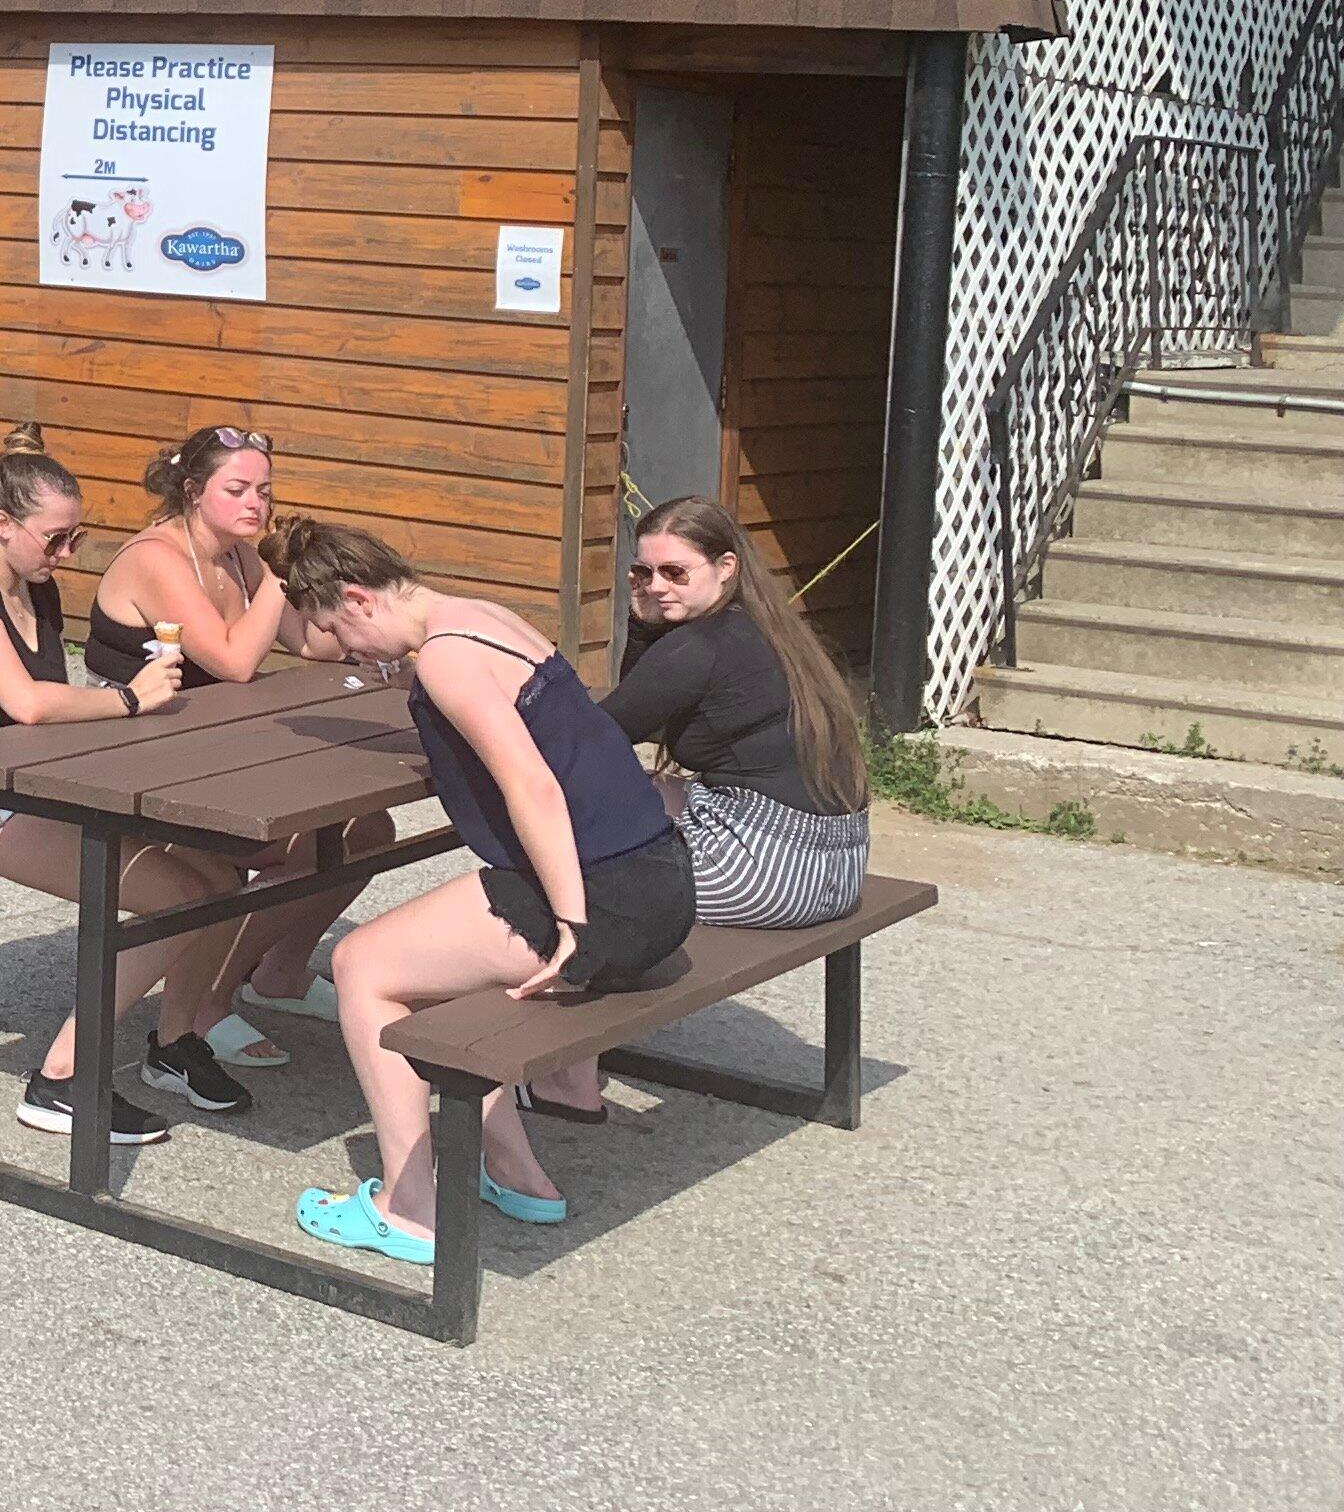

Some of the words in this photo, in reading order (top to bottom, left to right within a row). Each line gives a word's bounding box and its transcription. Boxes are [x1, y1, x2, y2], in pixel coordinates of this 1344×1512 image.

[70, 55, 144, 78] Please
[152, 56, 251, 80] Practice
[106, 87, 205, 116] Physical
[93, 119, 216, 151] Distancing
[167, 239, 238, 256] Kawartha
